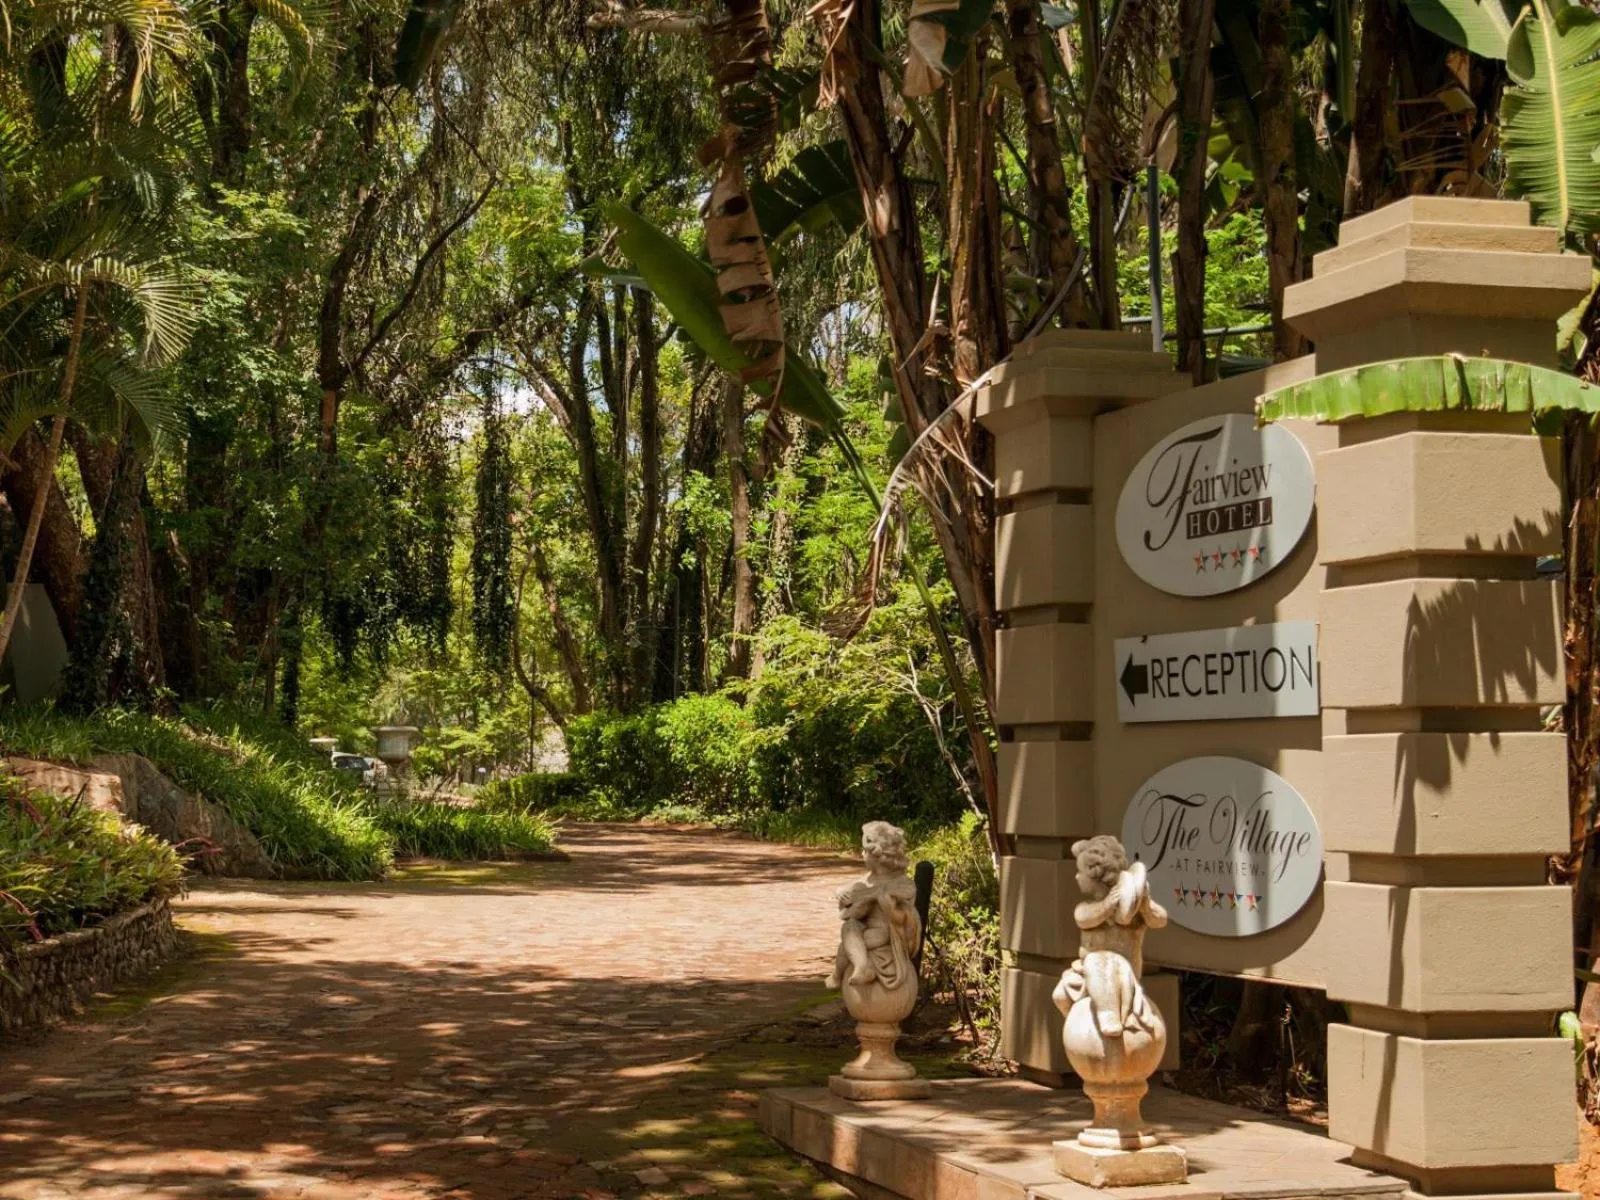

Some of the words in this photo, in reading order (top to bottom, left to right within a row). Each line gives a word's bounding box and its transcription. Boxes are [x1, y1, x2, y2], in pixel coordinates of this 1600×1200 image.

[1143, 424, 1273, 552] Fairview
[1189, 500, 1272, 538] HOTEL
[1151, 644, 1313, 699] RECEPTION
[1133, 789, 1208, 873] The
[1209, 790, 1311, 885] Village
